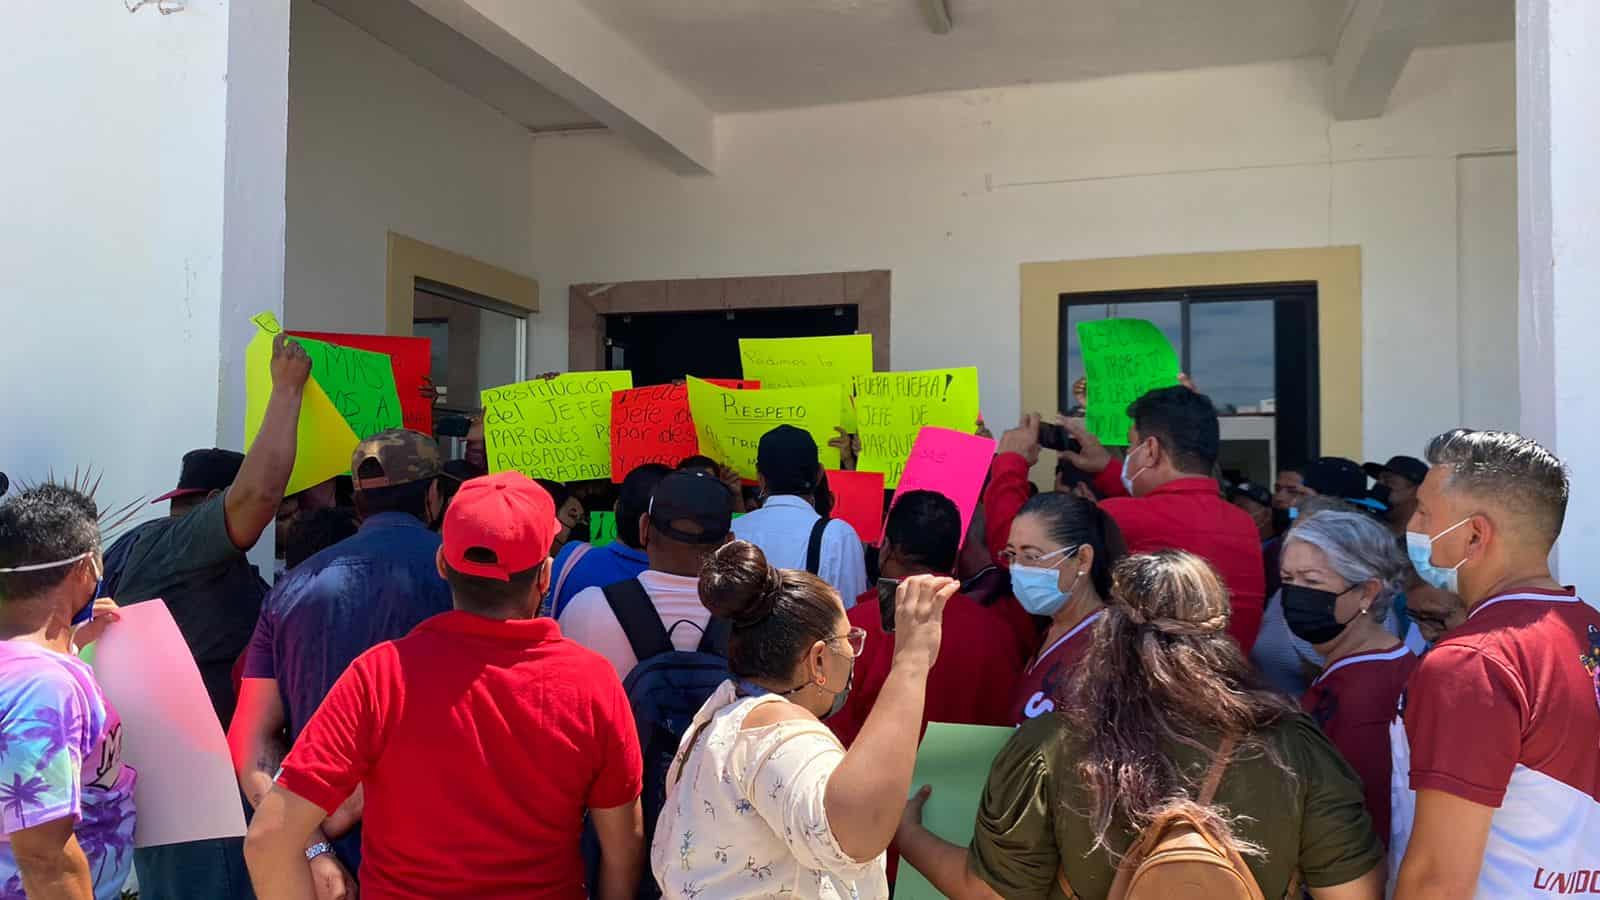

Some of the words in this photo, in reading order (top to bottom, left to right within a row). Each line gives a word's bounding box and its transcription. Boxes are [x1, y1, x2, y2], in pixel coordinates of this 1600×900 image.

[486, 400, 525, 425] del
[543, 399, 609, 425] JEFE
[861, 404, 894, 427] JEFE
[909, 403, 929, 426] DE
[490, 424, 581, 449] PARQUES
[614, 426, 656, 449] por
[728, 433, 759, 449] TRA
[495, 445, 593, 472] ACOSADOR
